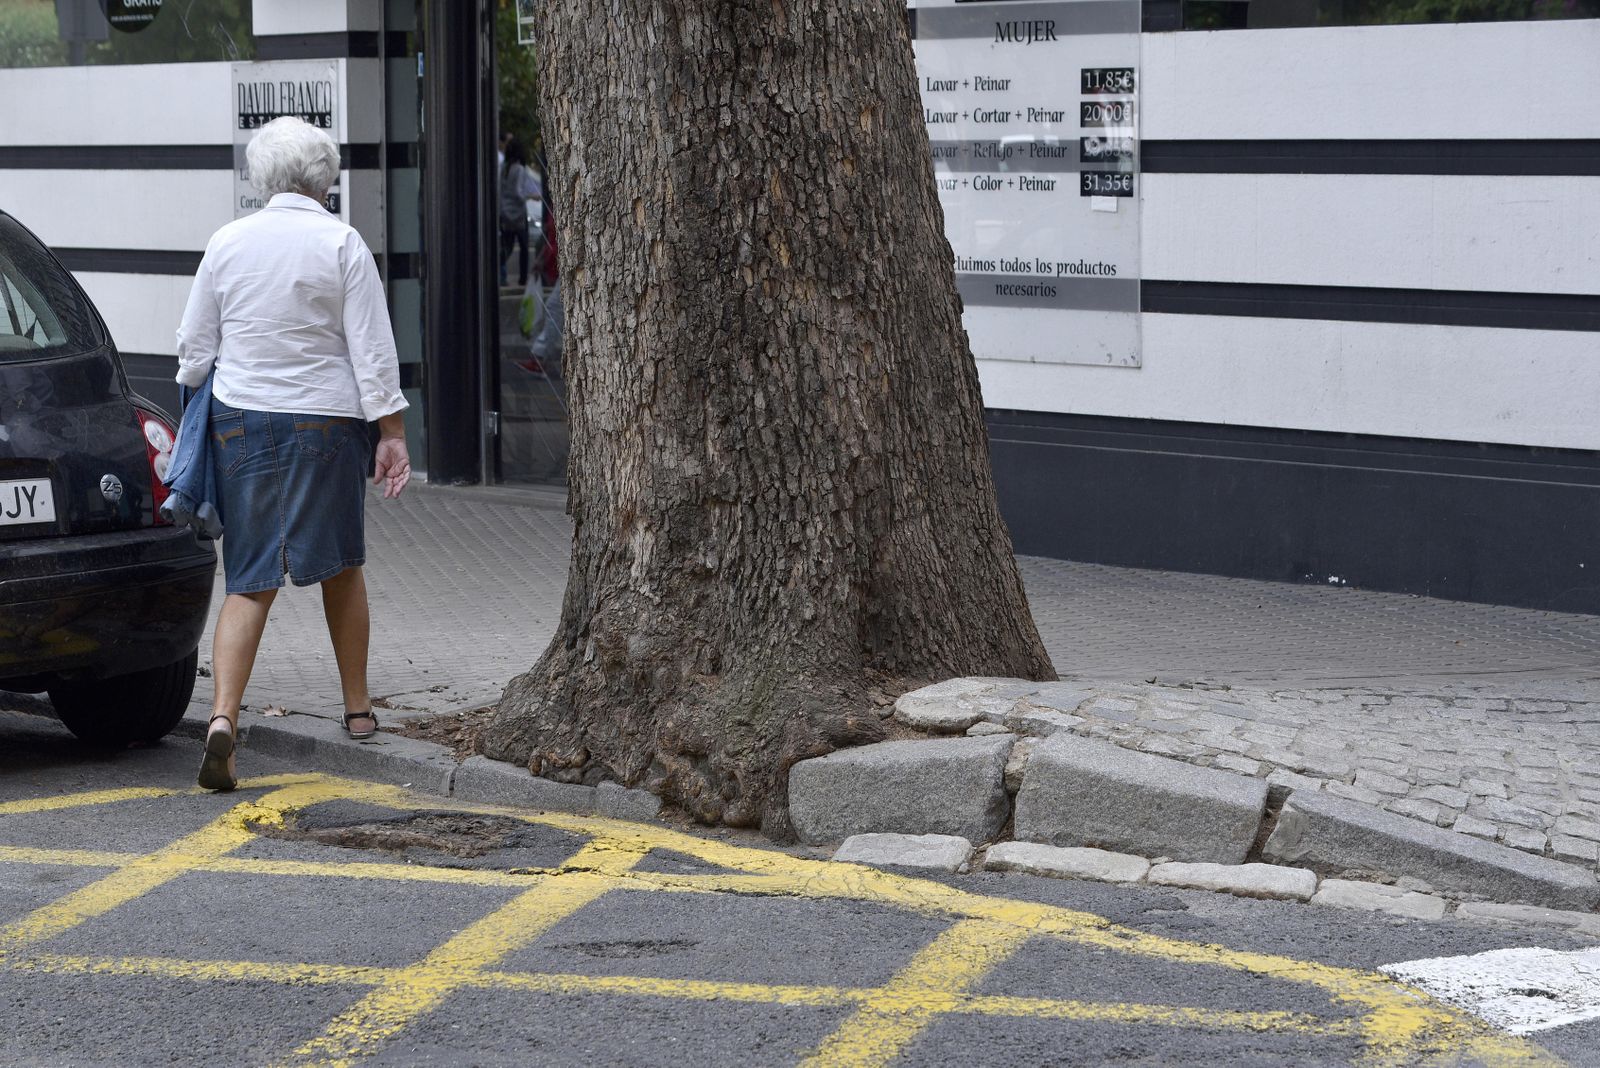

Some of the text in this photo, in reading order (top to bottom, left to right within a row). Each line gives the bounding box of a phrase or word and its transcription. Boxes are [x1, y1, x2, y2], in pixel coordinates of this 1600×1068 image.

[995, 20, 1058, 45] MUJER
[926, 71, 1133, 92] Lavar + Peinar 11,85€
[238, 81, 332, 114] DAVID FRANCO
[926, 108, 959, 123] Lavar
[962, 111, 969, 120] +
[973, 107, 1011, 123] Cortar
[1015, 111, 1022, 120] +
[1027, 107, 1065, 123] Peinar
[931, 146, 958, 158] avar
[974, 143, 1013, 161] Reflejo
[1018, 147, 1025, 155] +
[1030, 142, 1067, 158] Peinar
[936, 173, 1131, 191] var + Color + Peinar 31,35€
[954, 255, 1117, 277] luimos todos los productos
[996, 282, 1057, 297] necesarios
[0, 485, 37, 519] JY
